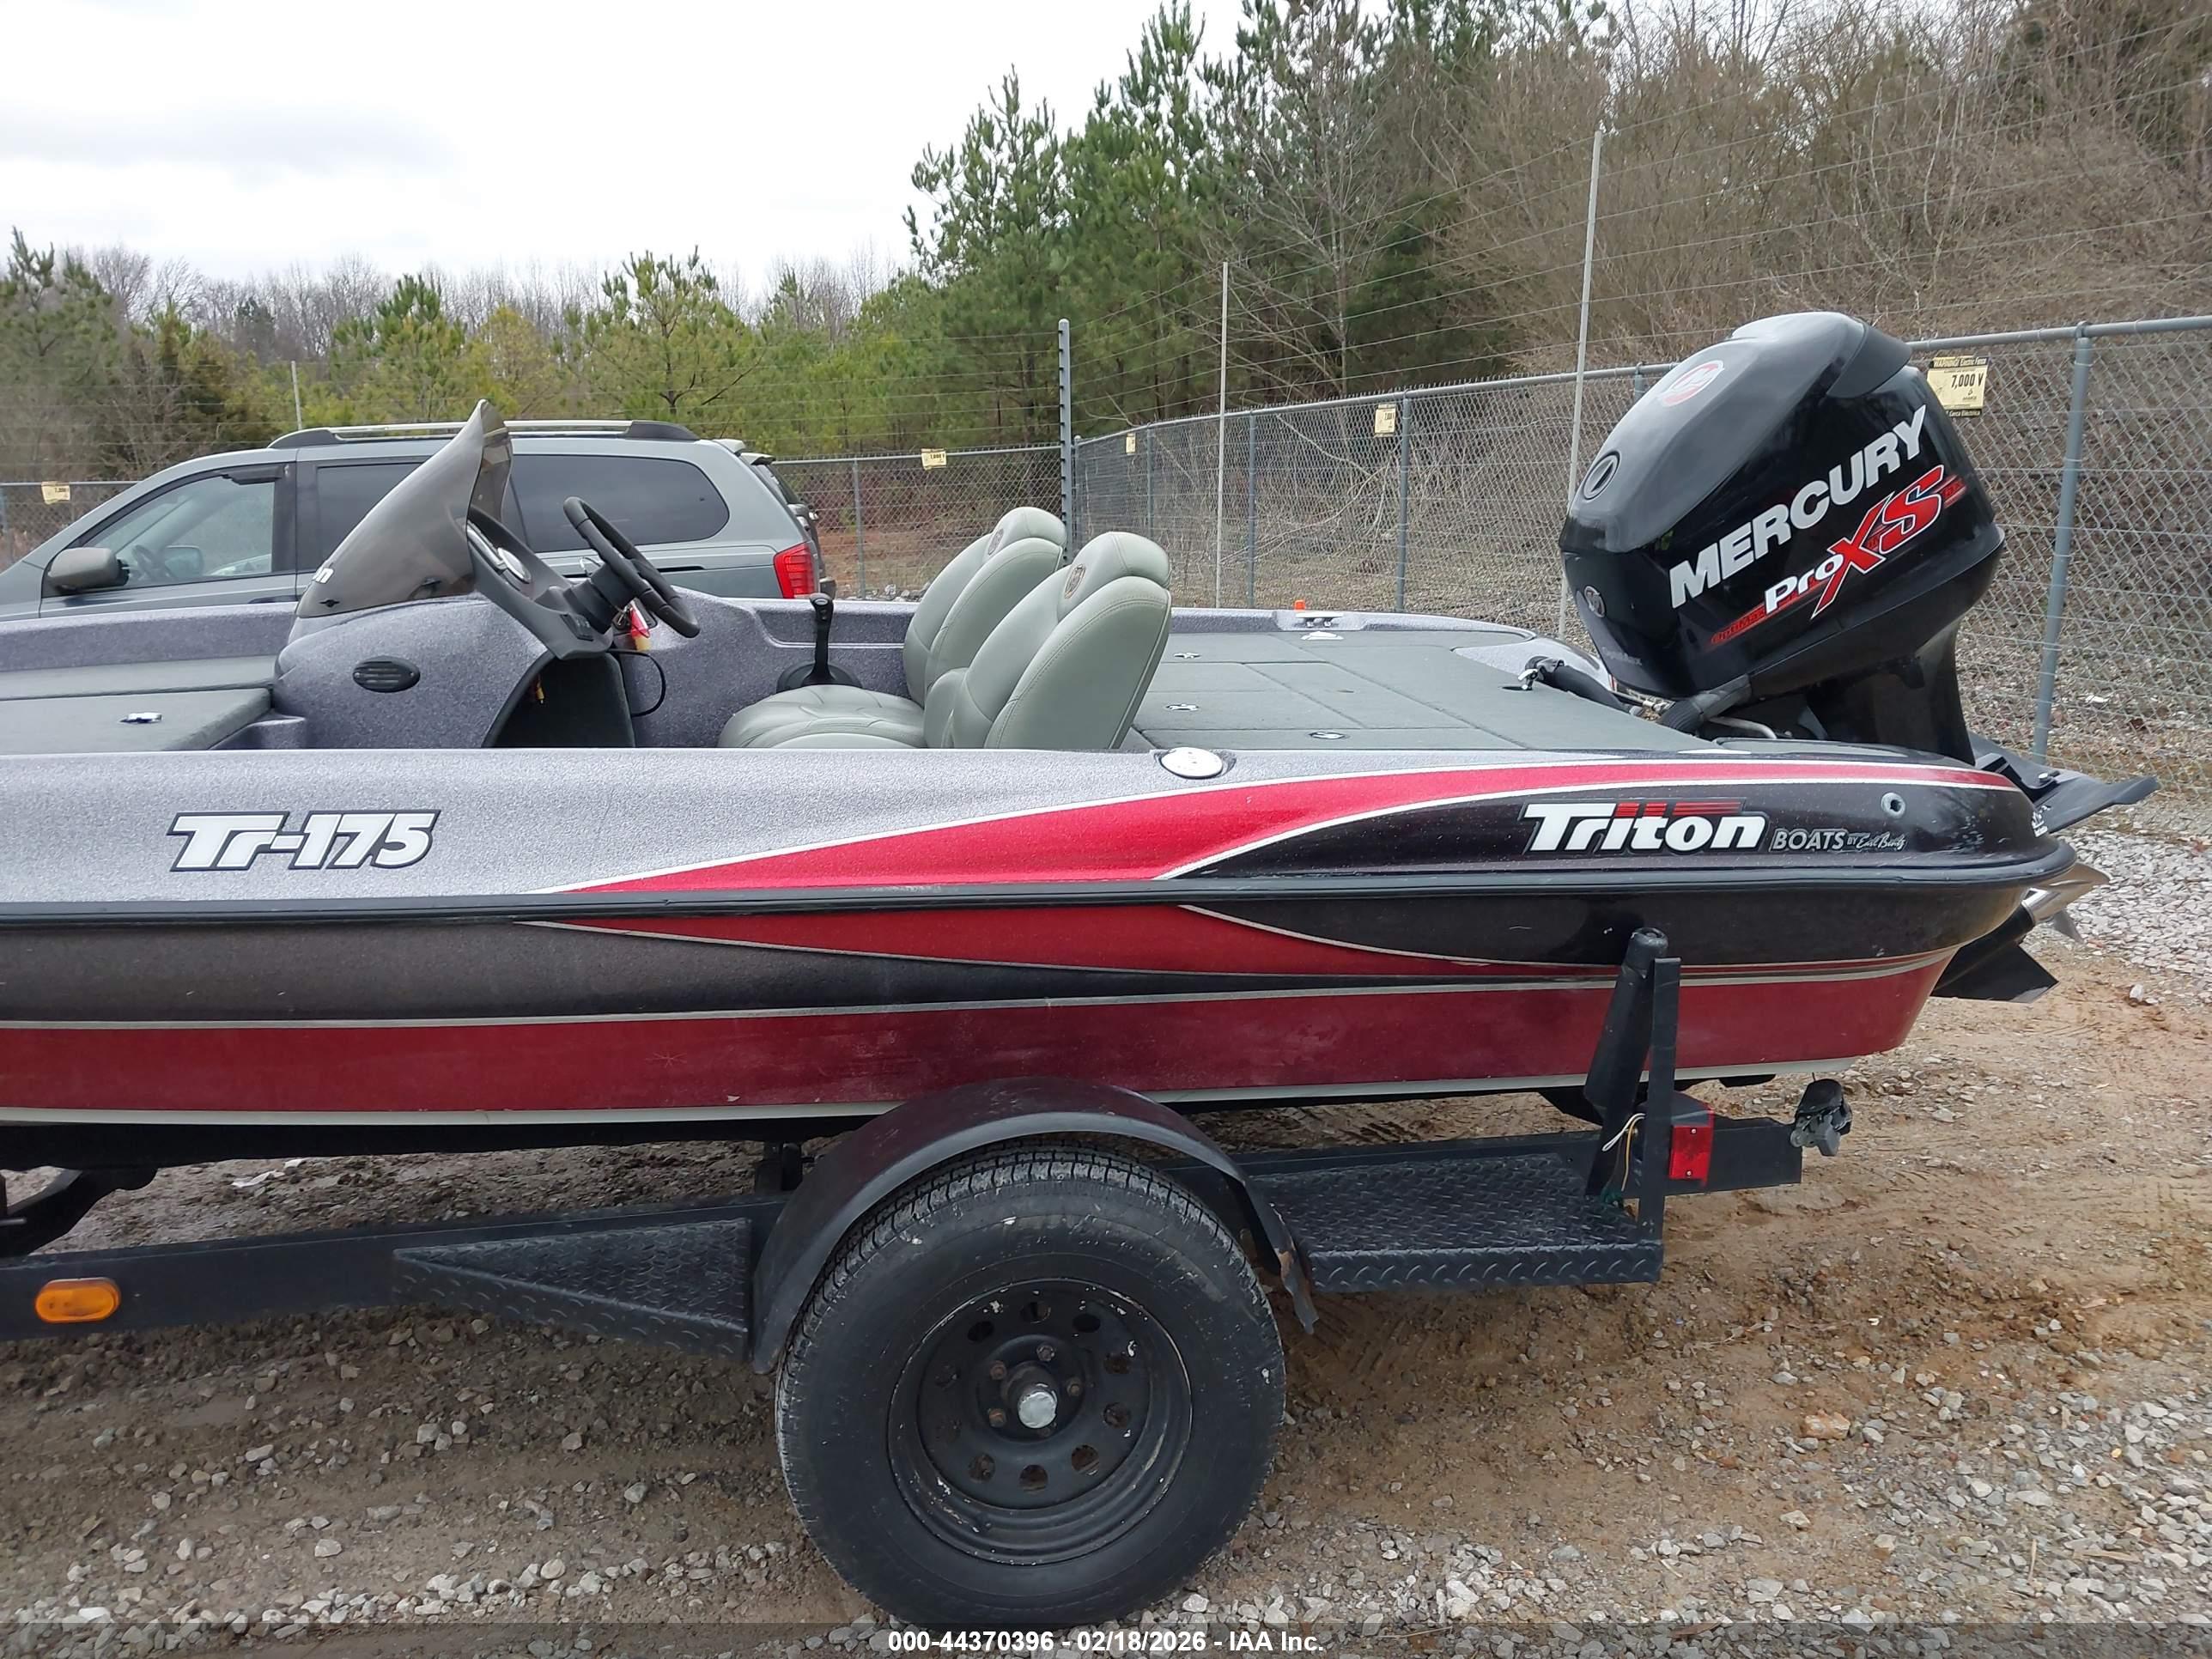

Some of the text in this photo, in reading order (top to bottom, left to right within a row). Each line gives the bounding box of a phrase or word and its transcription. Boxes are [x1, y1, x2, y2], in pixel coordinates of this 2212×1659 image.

[1951, 373, 1984, 390] 7,000 V
[1668, 404, 1926, 609] MERCURY
[1523, 801, 1767, 853] Triton
[1771, 830, 1846, 850] BOATS
